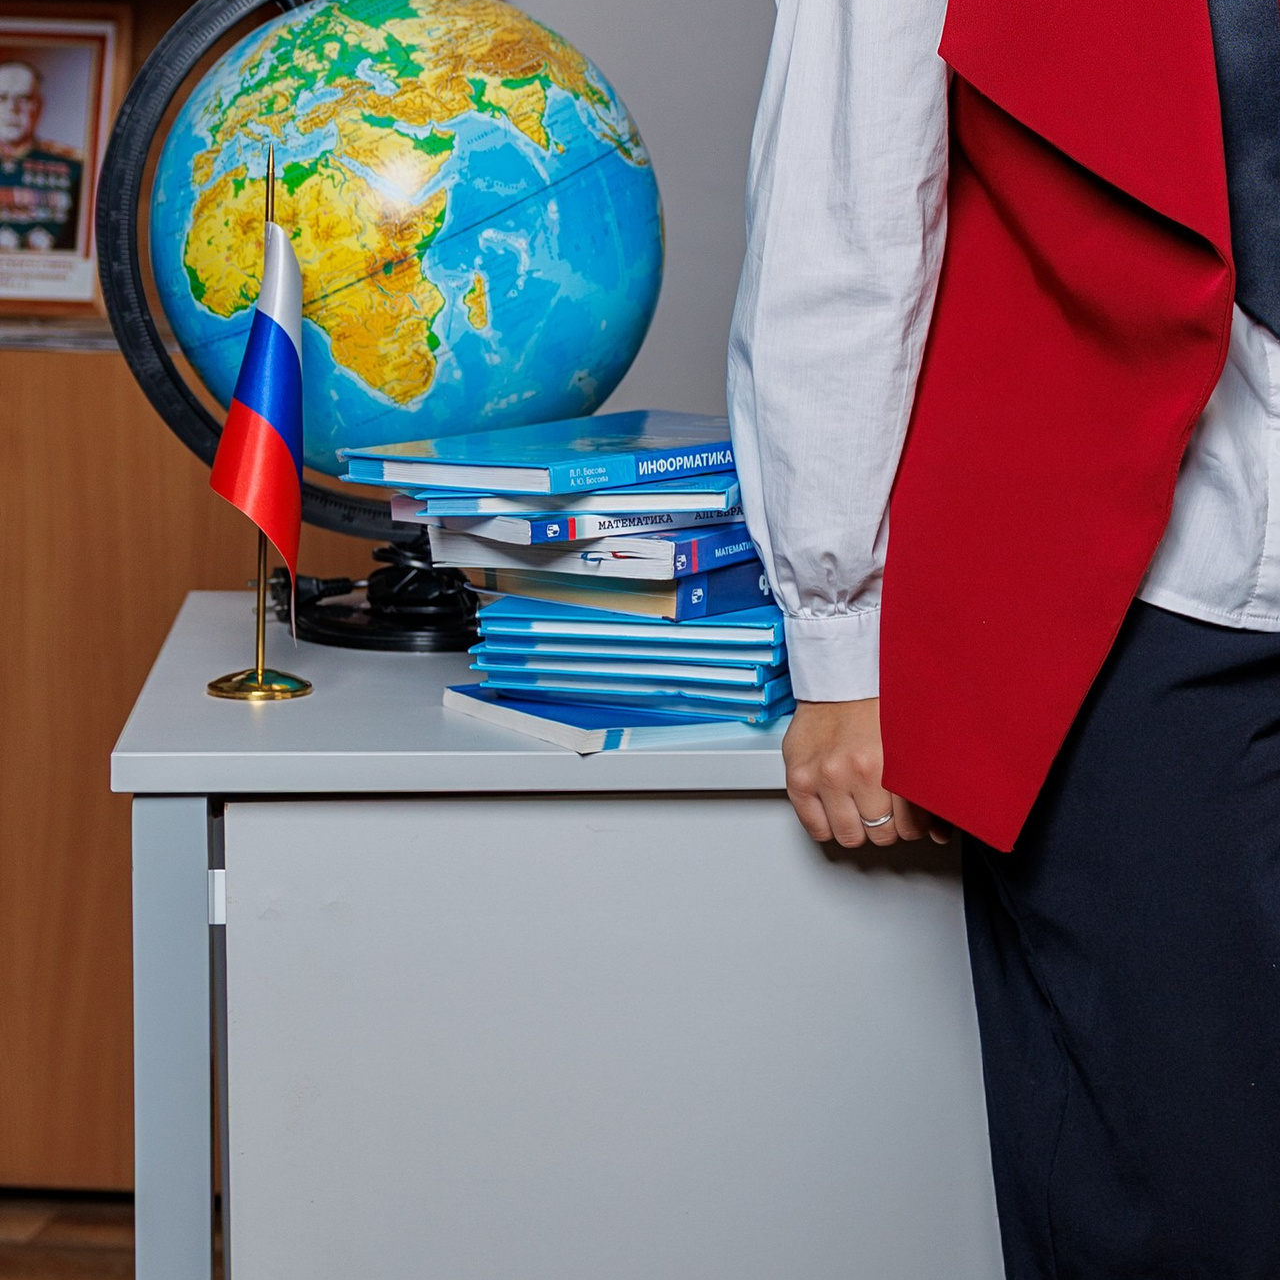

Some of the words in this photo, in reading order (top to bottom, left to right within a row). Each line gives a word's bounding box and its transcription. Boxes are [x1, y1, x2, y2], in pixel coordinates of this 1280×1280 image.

[638, 450, 733, 476] ИНФОРМАТИКА
[583, 467, 606, 476] Босова
[586, 476, 609, 485] Босова
[598, 514, 673, 530] МАТЕМАТИКА
